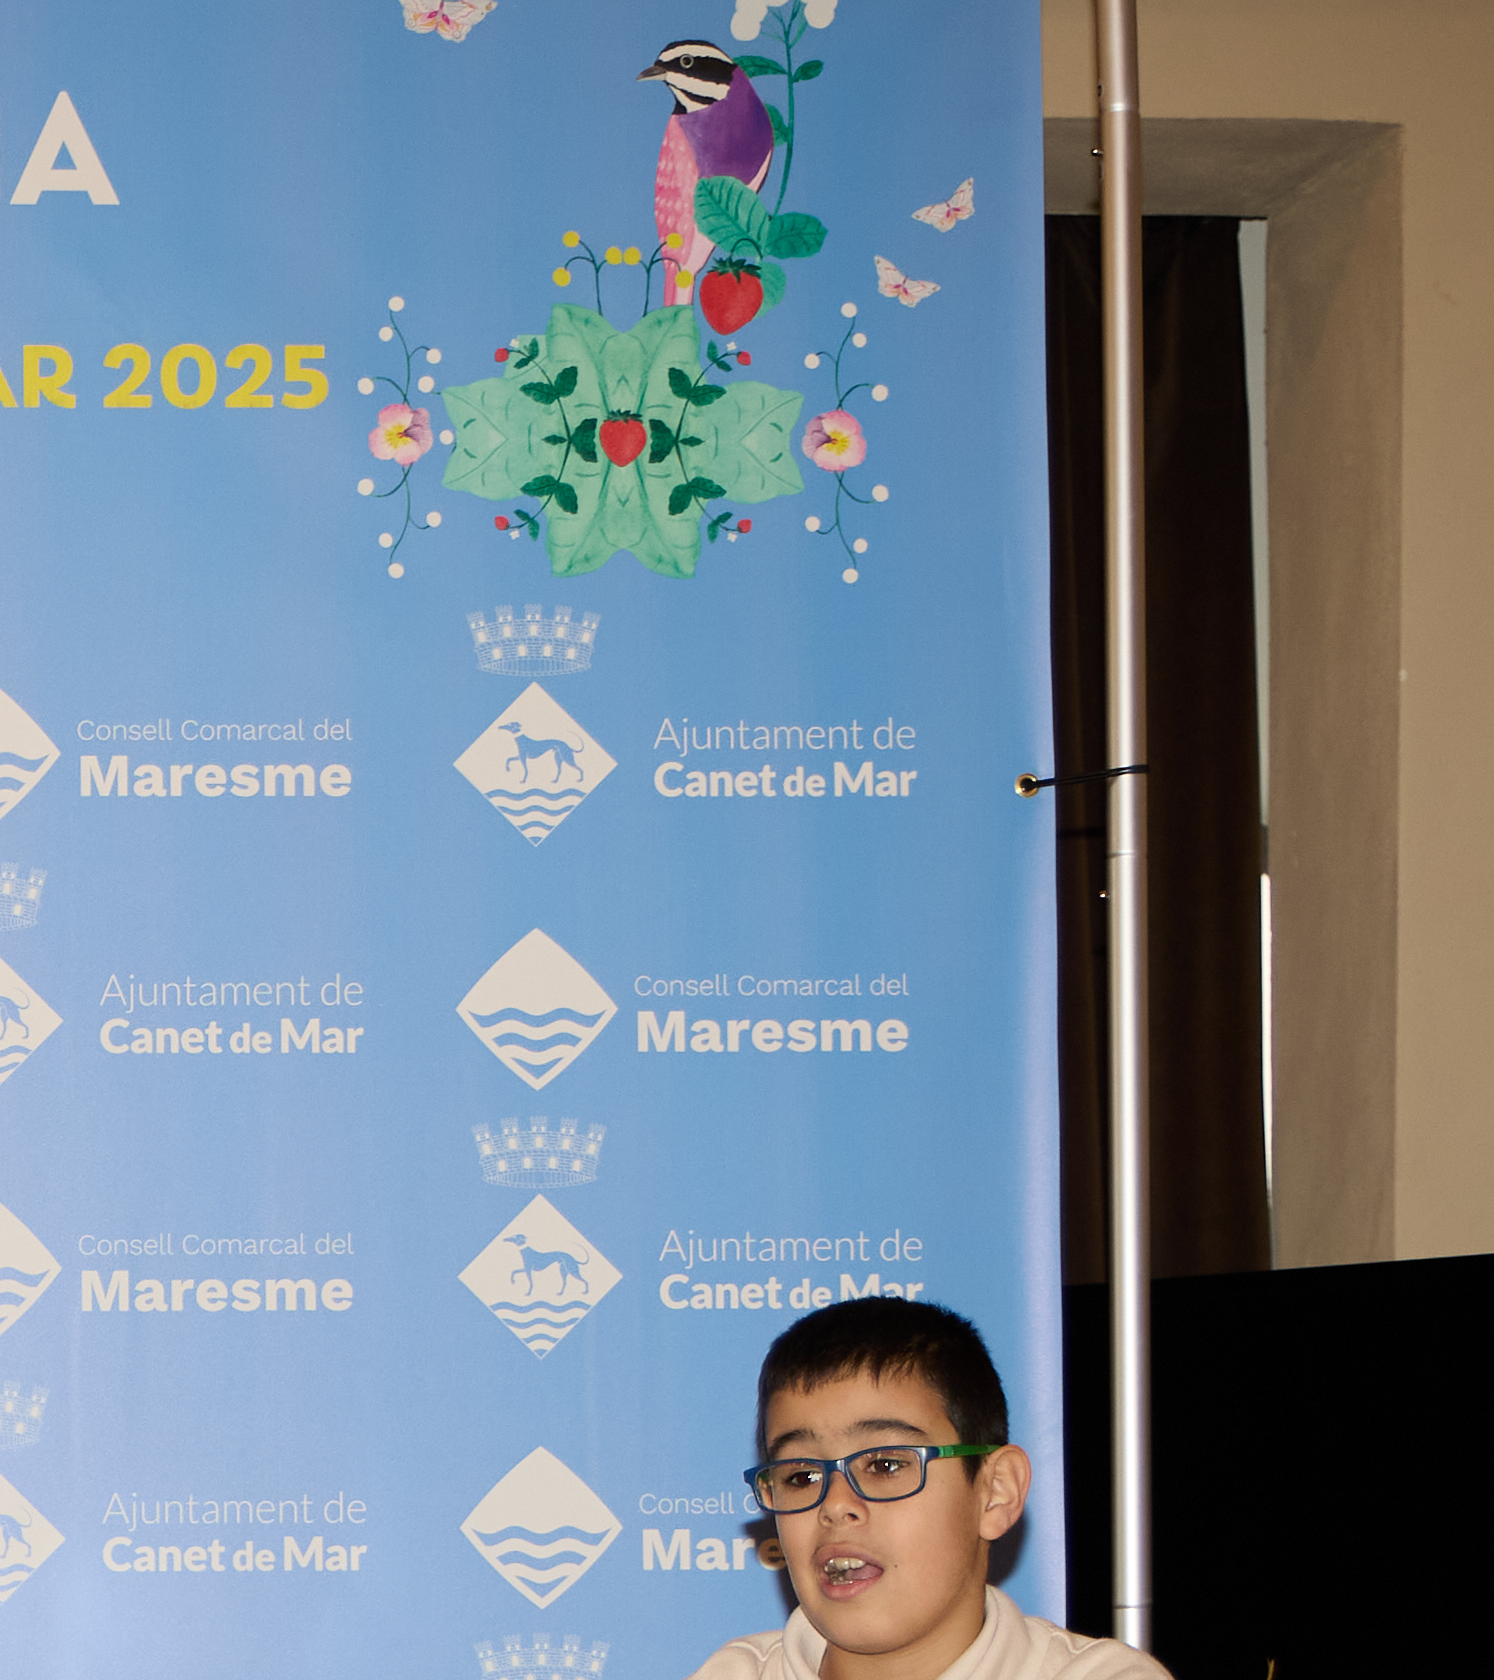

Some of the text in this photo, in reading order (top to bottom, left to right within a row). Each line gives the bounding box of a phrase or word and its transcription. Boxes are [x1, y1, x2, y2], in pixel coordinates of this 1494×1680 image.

[101, 342, 330, 410] 2025
[77, 718, 352, 741] Consell Comarcal del
[652, 717, 916, 753] Ajuntament de
[80, 756, 351, 797] Maresme
[654, 761, 915, 798] Canet de Mar
[658, 1229, 923, 1265] Ajuntament de
[659, 1273, 781, 1309] Canet
[790, 1277, 832, 1309] de
[639, 1492, 734, 1514] Consell
[642, 1528, 786, 1571] Mare
